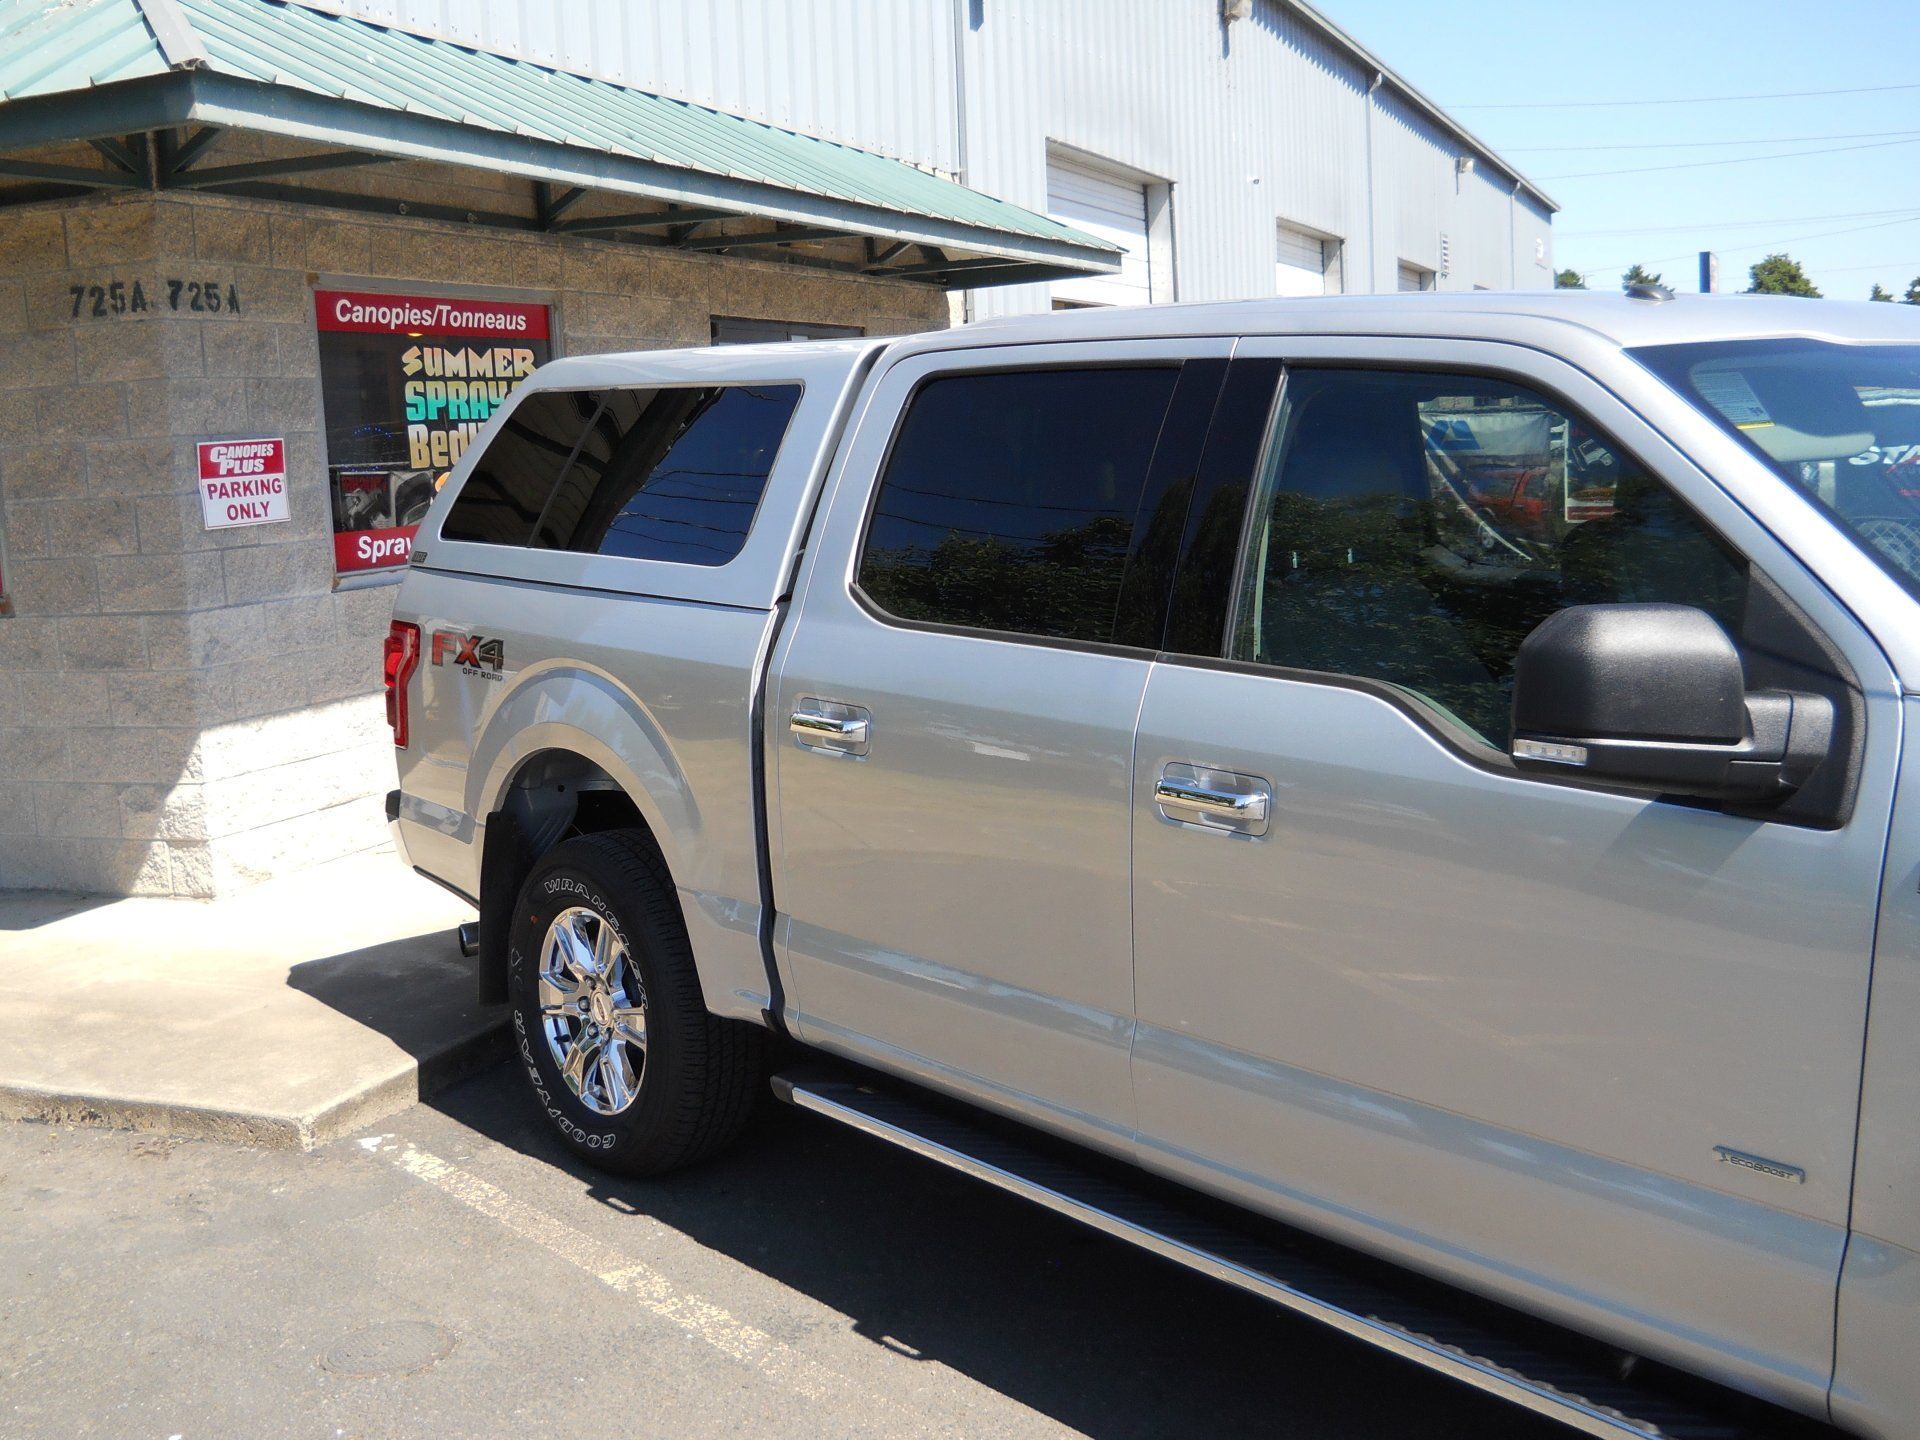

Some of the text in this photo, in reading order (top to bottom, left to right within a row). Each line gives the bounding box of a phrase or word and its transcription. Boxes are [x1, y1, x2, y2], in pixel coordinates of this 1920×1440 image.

[70, 279, 241, 318] 725A 725A
[335, 298, 527, 331] Canopies/Tonneaus
[401, 345, 537, 377] SUMMER
[210, 443, 274, 463] CANOPIES
[219, 457, 265, 475] PLUS
[207, 477, 282, 500] PARKING
[226, 501, 270, 521] ONLY
[432, 629, 504, 674] FX4
[462, 667, 503, 682] OFF ROAD
[544, 878, 649, 1010] WRANGLER
[514, 1009, 616, 1149] GOODYEAR
